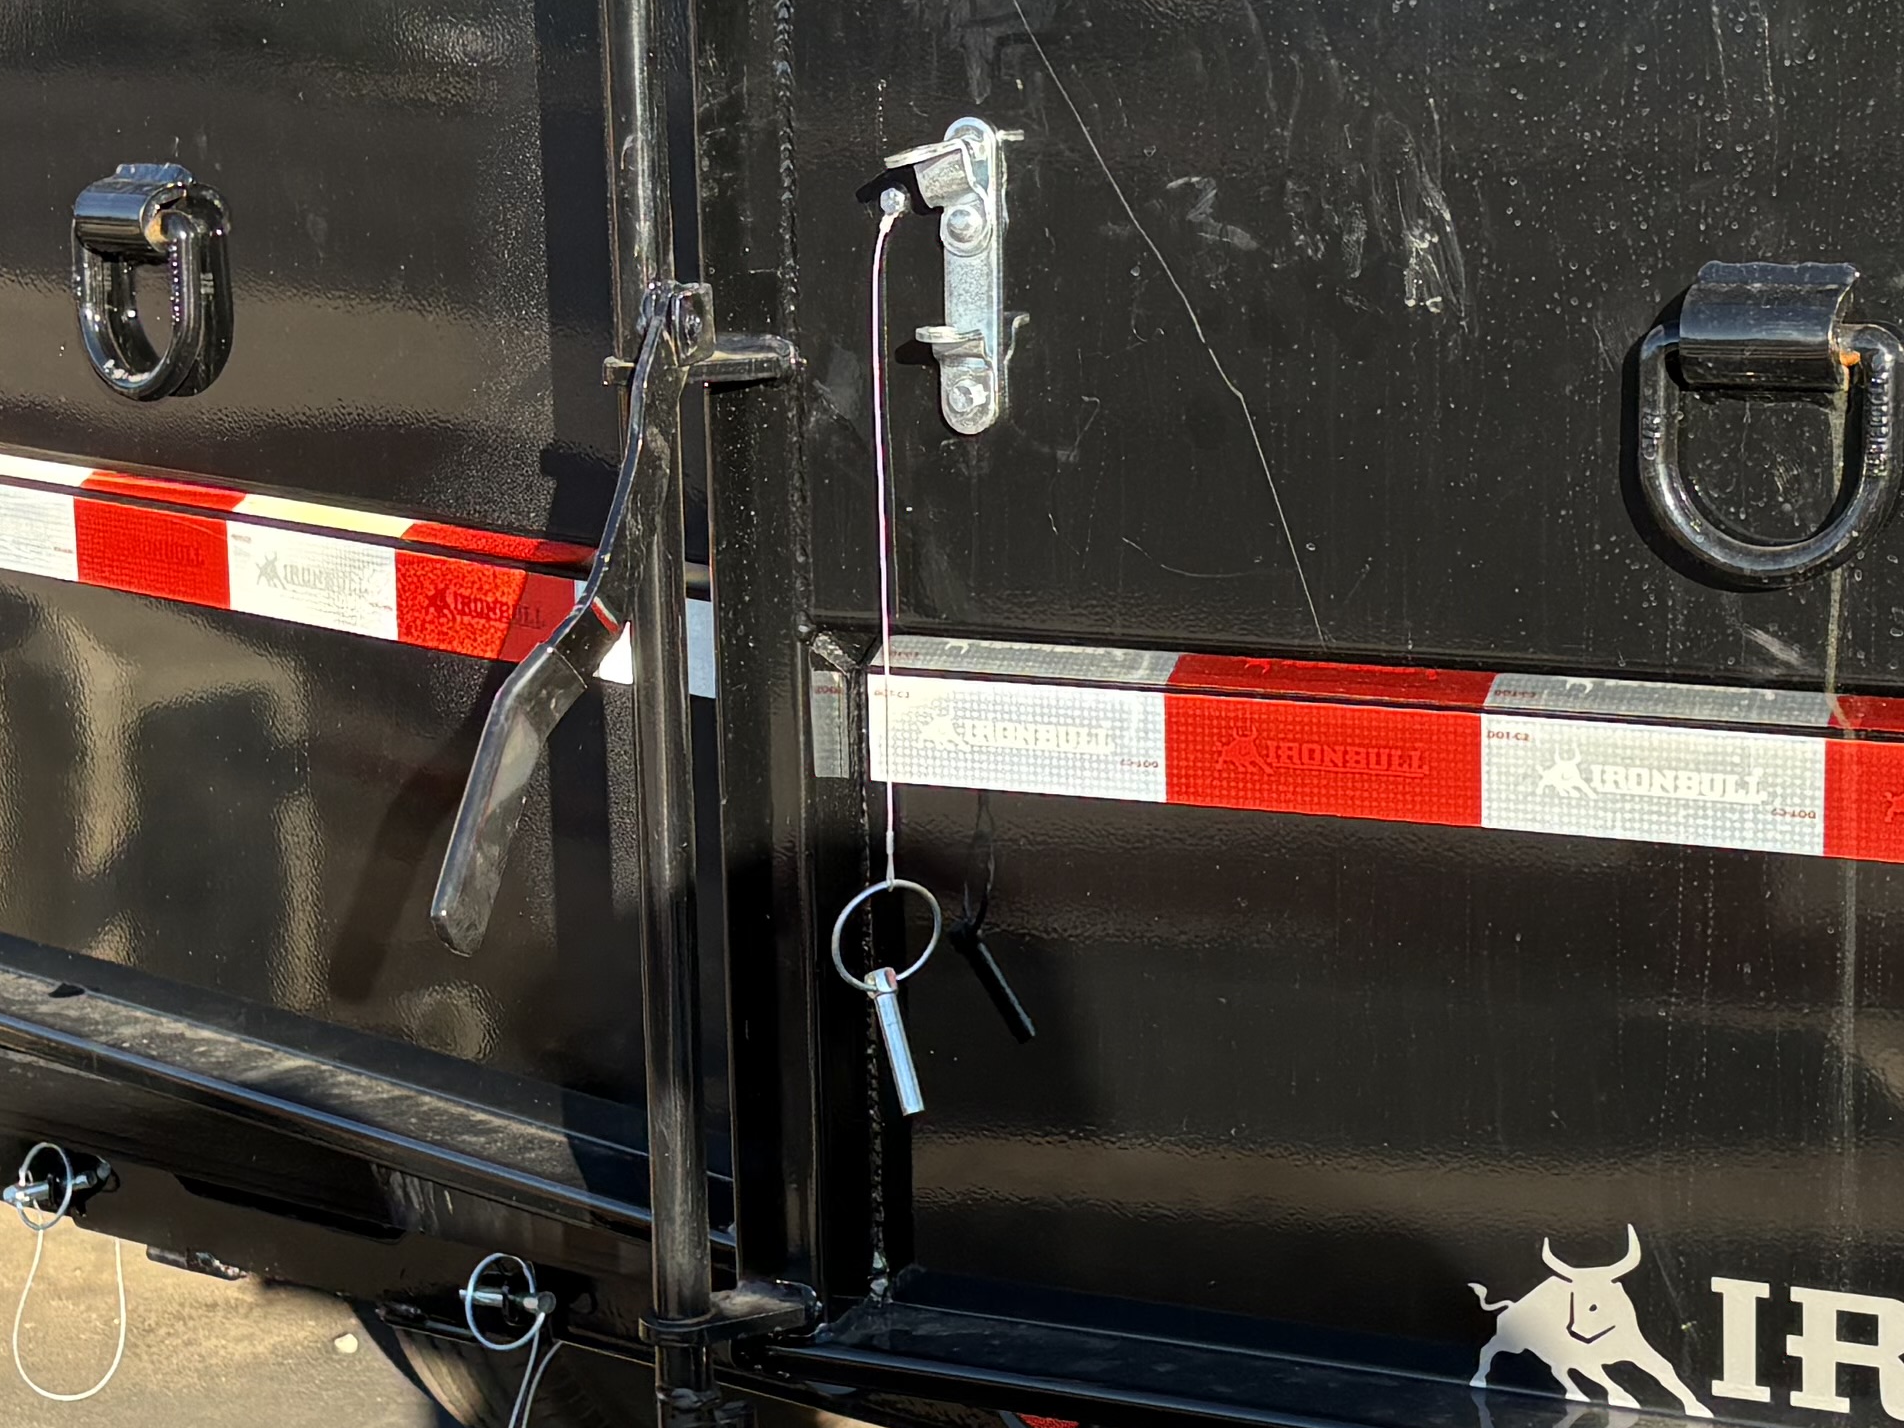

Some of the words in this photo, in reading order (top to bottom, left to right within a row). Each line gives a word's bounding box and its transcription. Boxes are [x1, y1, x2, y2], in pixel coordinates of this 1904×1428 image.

[1486, 729, 1530, 741] DOT-C2
[1265, 740, 1429, 774] IRONBULL
[1589, 763, 1768, 803] IRONBULL
[1770, 807, 1817, 819] DOT-C2
